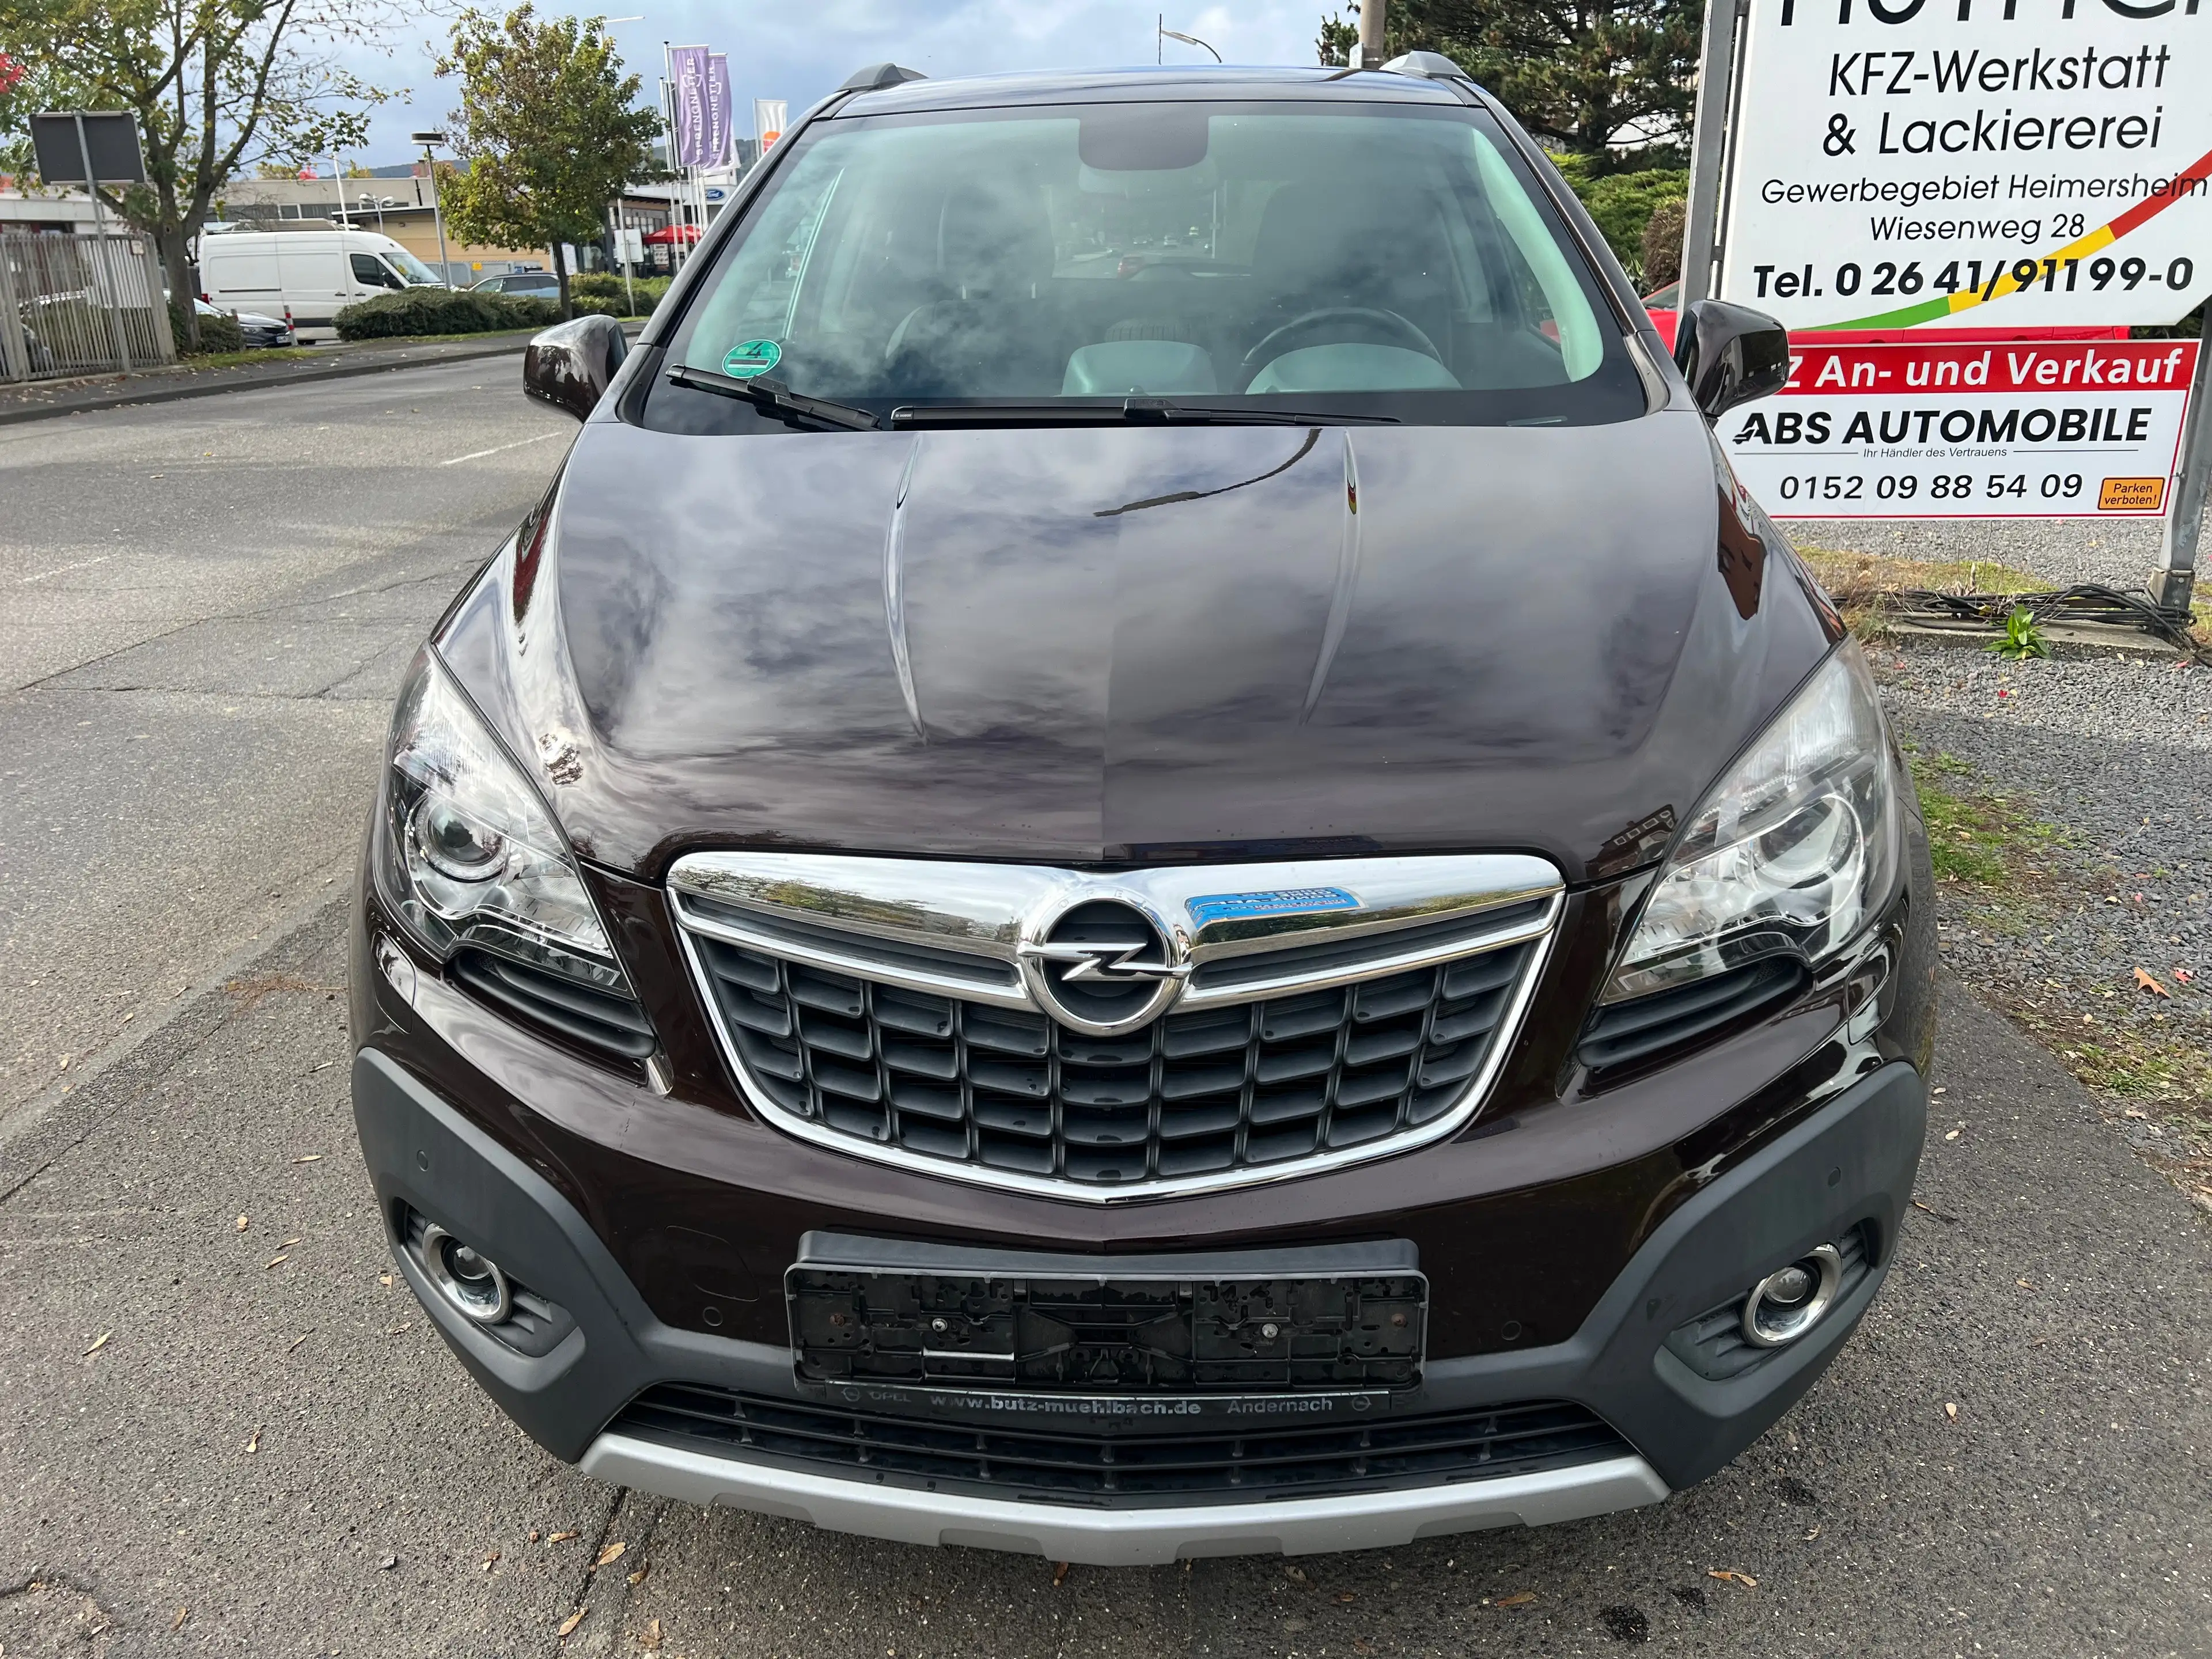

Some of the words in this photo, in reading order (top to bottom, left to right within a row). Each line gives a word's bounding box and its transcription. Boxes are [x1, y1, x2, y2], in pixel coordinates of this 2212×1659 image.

[1829, 44, 2171, 96] KFZ-Werkstatt
[1823, 113, 1857, 157] &
[1878, 105, 2163, 154] Lackiererei
[1762, 175, 2000, 207] Gewerbegebiet
[2008, 172, 2208, 199] Heimersheim
[1870, 216, 2041, 245] Wiesenweg
[2051, 213, 2085, 238] 28
[1753, 264, 1823, 298] Tel.
[745, 342, 764, 358] 4
[1815, 355, 1892, 388] An-
[1906, 350, 1991, 387] und
[2008, 347, 2183, 385] Verkauf
[1732, 411, 1832, 445] ABS
[1841, 407, 2153, 444] AUTOMOBILE
[1863, 448, 1877, 458] Ihr
[1881, 448, 1923, 458] Händler
[1926, 447, 1946, 457] des
[1949, 447, 2008, 457] Vertrauens
[1779, 475, 1864, 500] 0152
[1876, 475, 1918, 499] 09
[1930, 474, 1973, 499] 88
[1986, 474, 2028, 499] 54
[2040, 473, 2083, 498] 09
[2104, 494, 2157, 505] verboten!
[2113, 482, 2153, 494] Parken
[929, 1395, 1202, 1415] www.butz-muehlbach.de
[1227, 1397, 1333, 1414] Andernach
